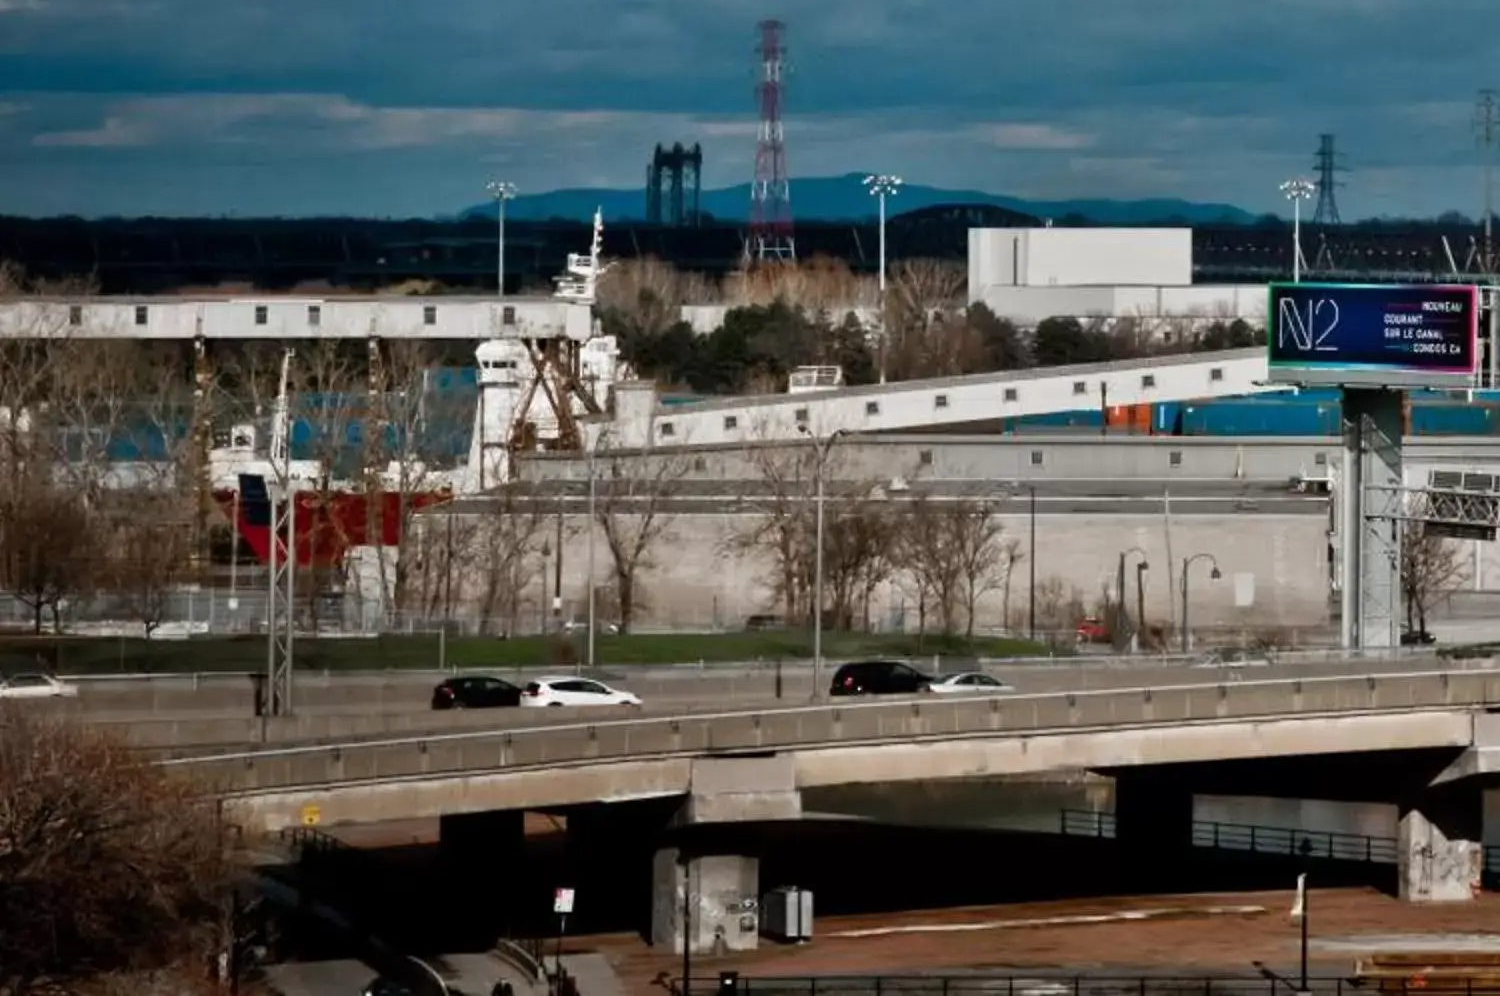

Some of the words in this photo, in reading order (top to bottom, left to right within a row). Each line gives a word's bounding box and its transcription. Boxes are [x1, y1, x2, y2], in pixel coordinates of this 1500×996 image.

[1421, 301, 1462, 312] NOUVEAU
[1279, 297, 1339, 350] N2
[1384, 314, 1423, 324] COURANT
[1384, 327, 1401, 338] SUR
[1403, 329, 1413, 339] LE
[1415, 329, 1443, 340] CANAL
